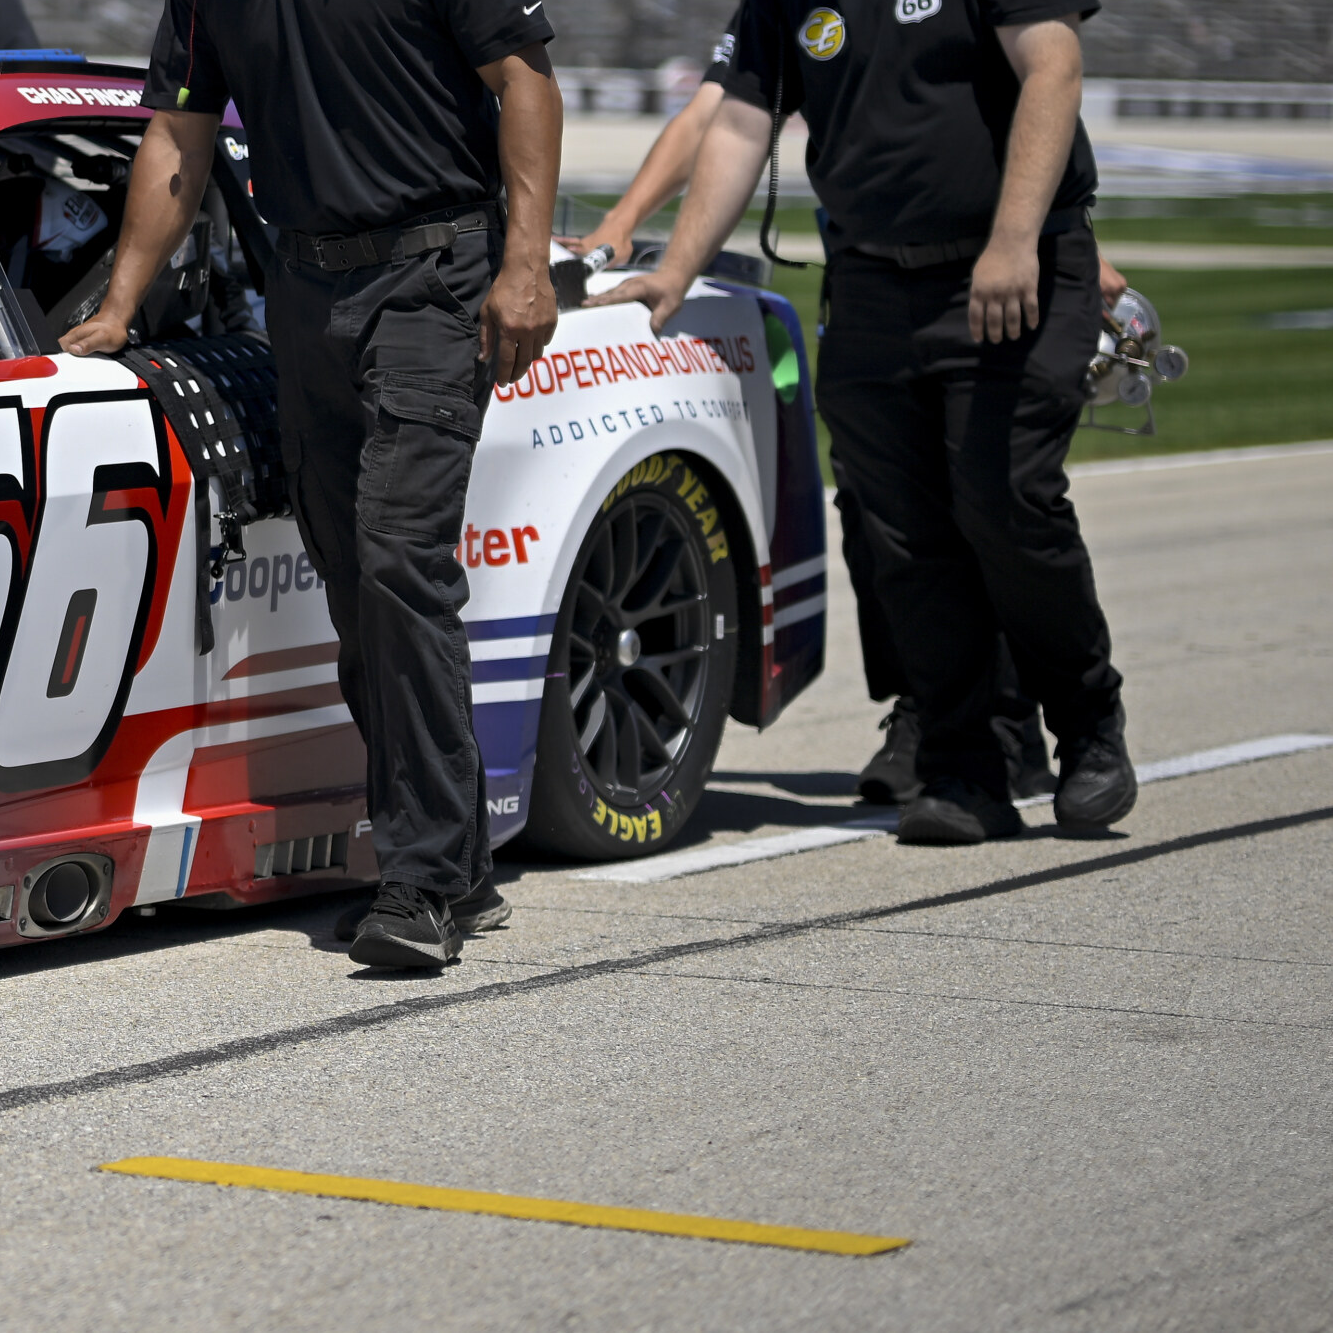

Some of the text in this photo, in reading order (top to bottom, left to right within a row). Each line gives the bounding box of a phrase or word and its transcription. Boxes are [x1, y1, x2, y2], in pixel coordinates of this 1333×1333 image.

[17, 87, 143, 107] CHAD FINCH
[532, 404, 664, 449] ADDICTED
[674, 400, 697, 419] TO
[592, 796, 663, 844] EAGLE
